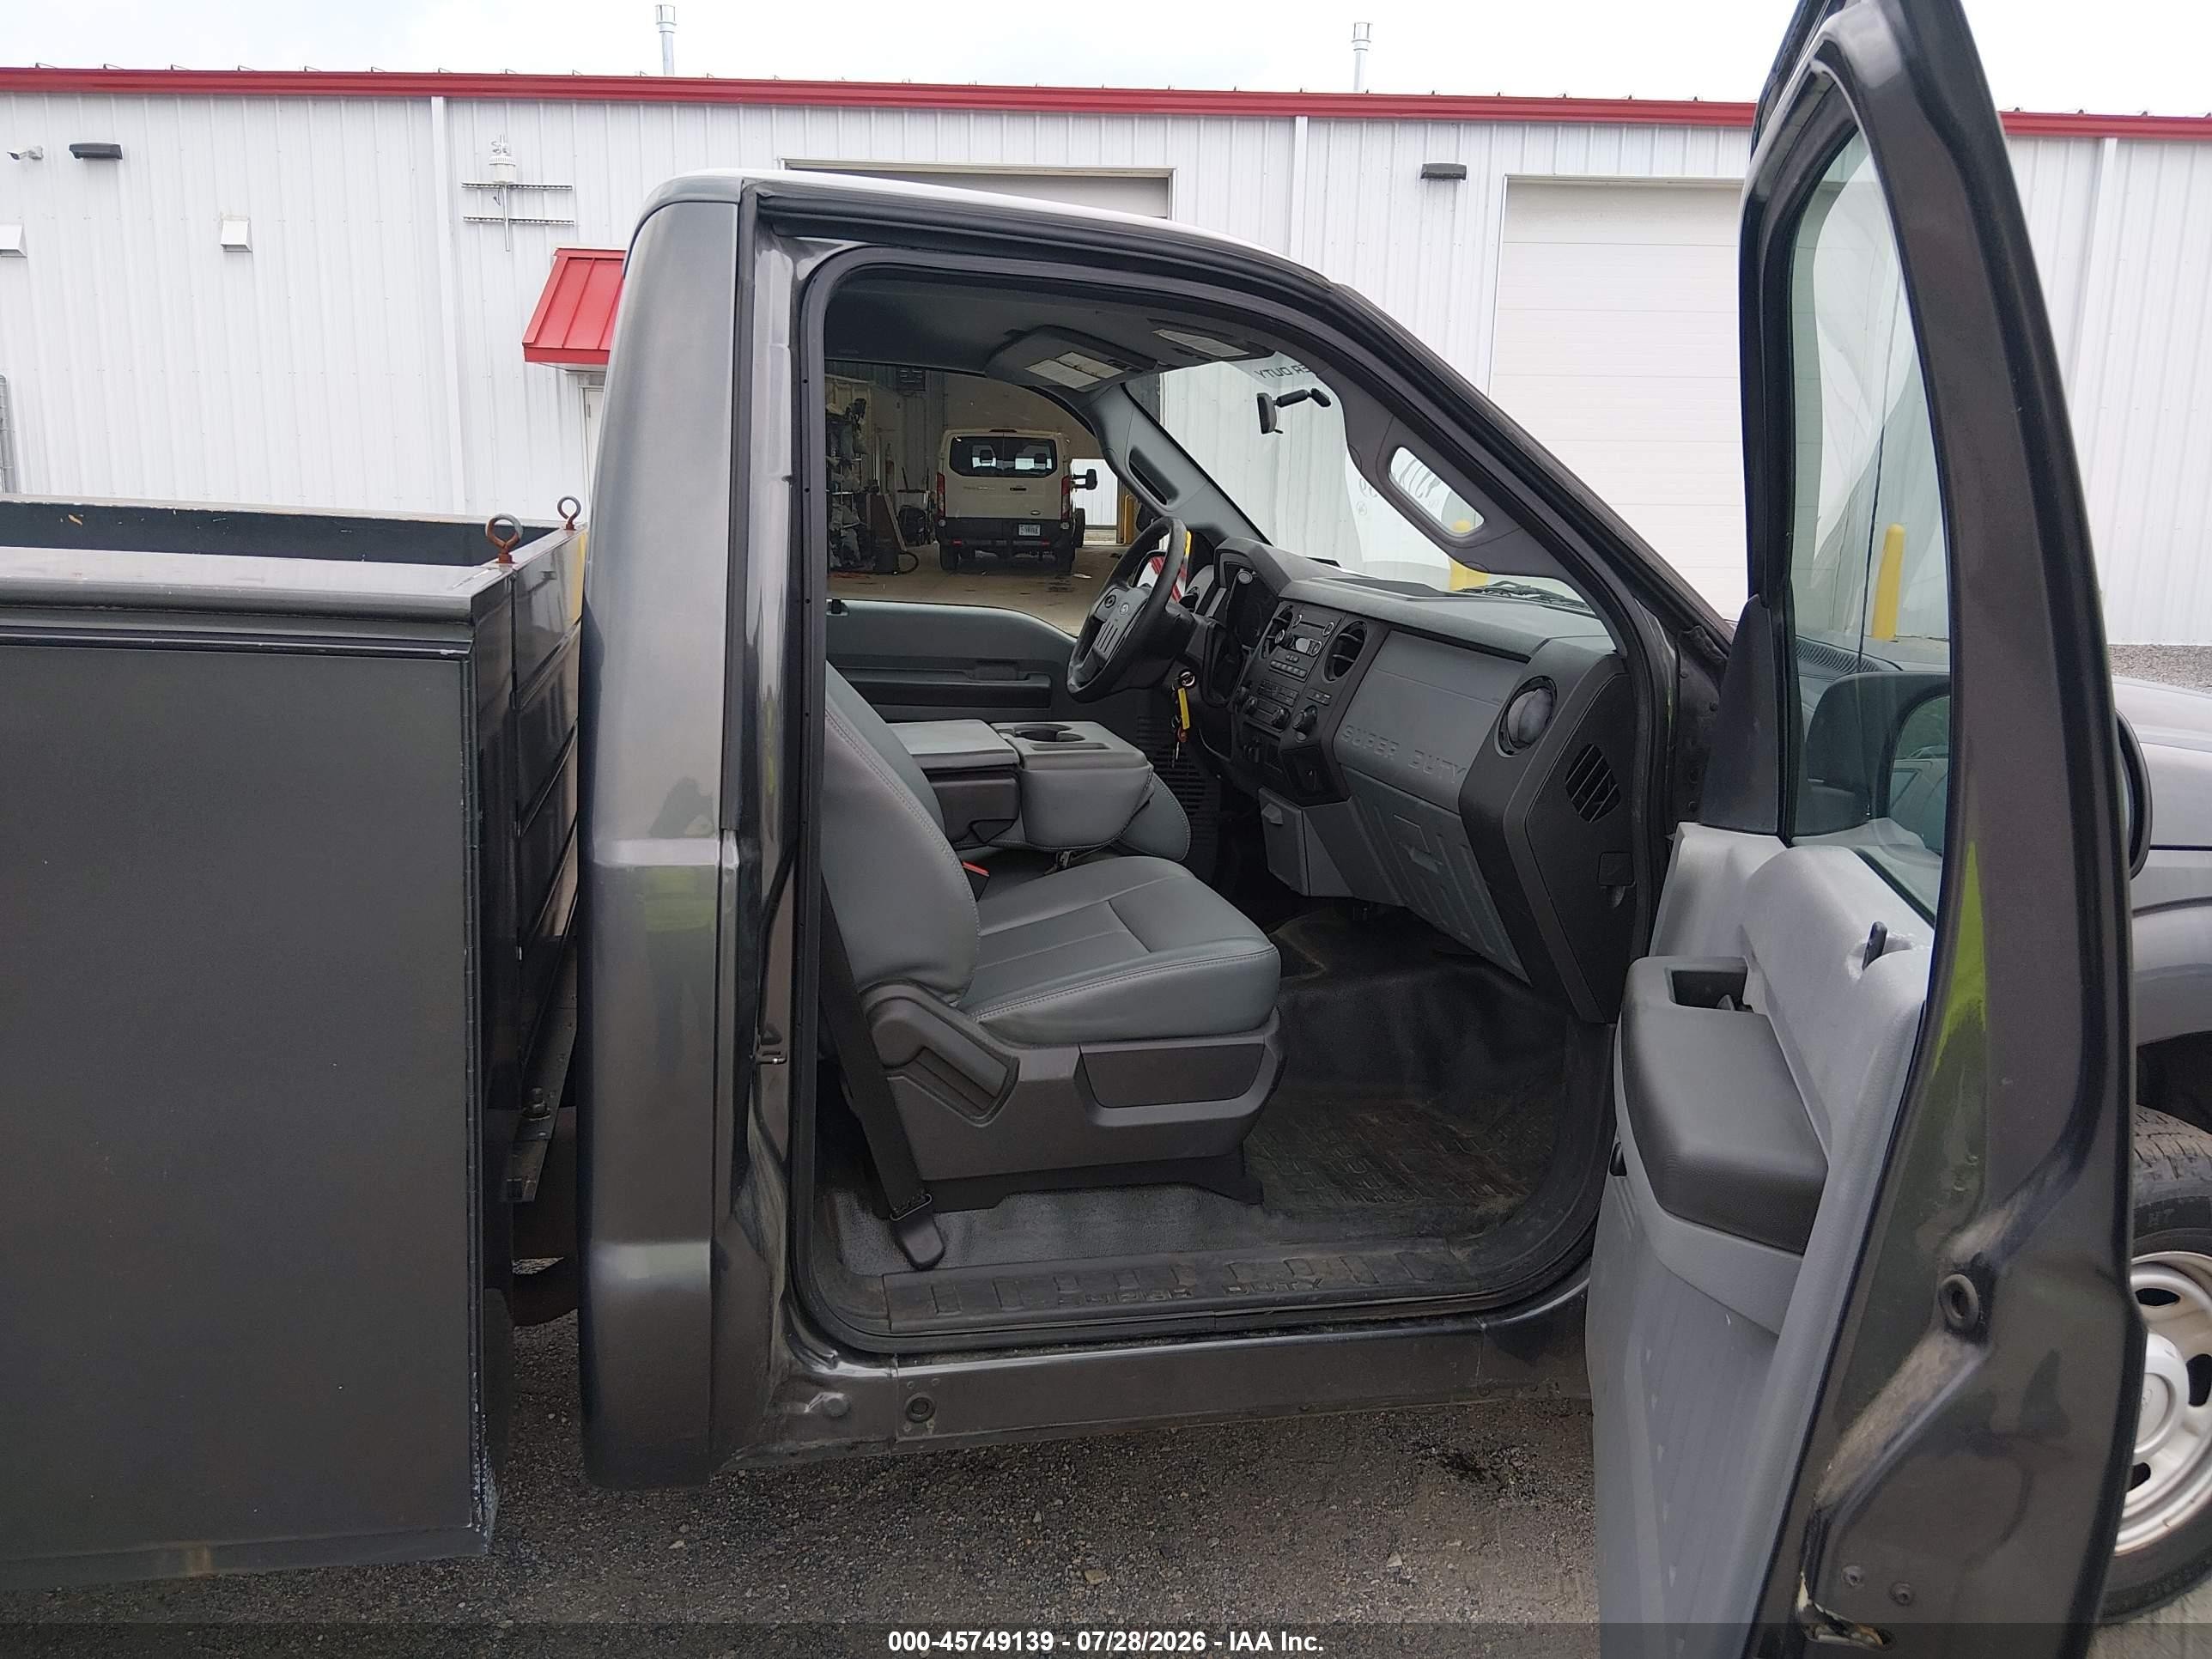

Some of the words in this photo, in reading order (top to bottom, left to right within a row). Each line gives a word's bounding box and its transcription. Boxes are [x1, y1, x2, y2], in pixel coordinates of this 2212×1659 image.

[1341, 724, 1401, 761] SUPER
[1407, 749, 1468, 784] DUTY
[1222, 1278, 1323, 1295] DUTY
